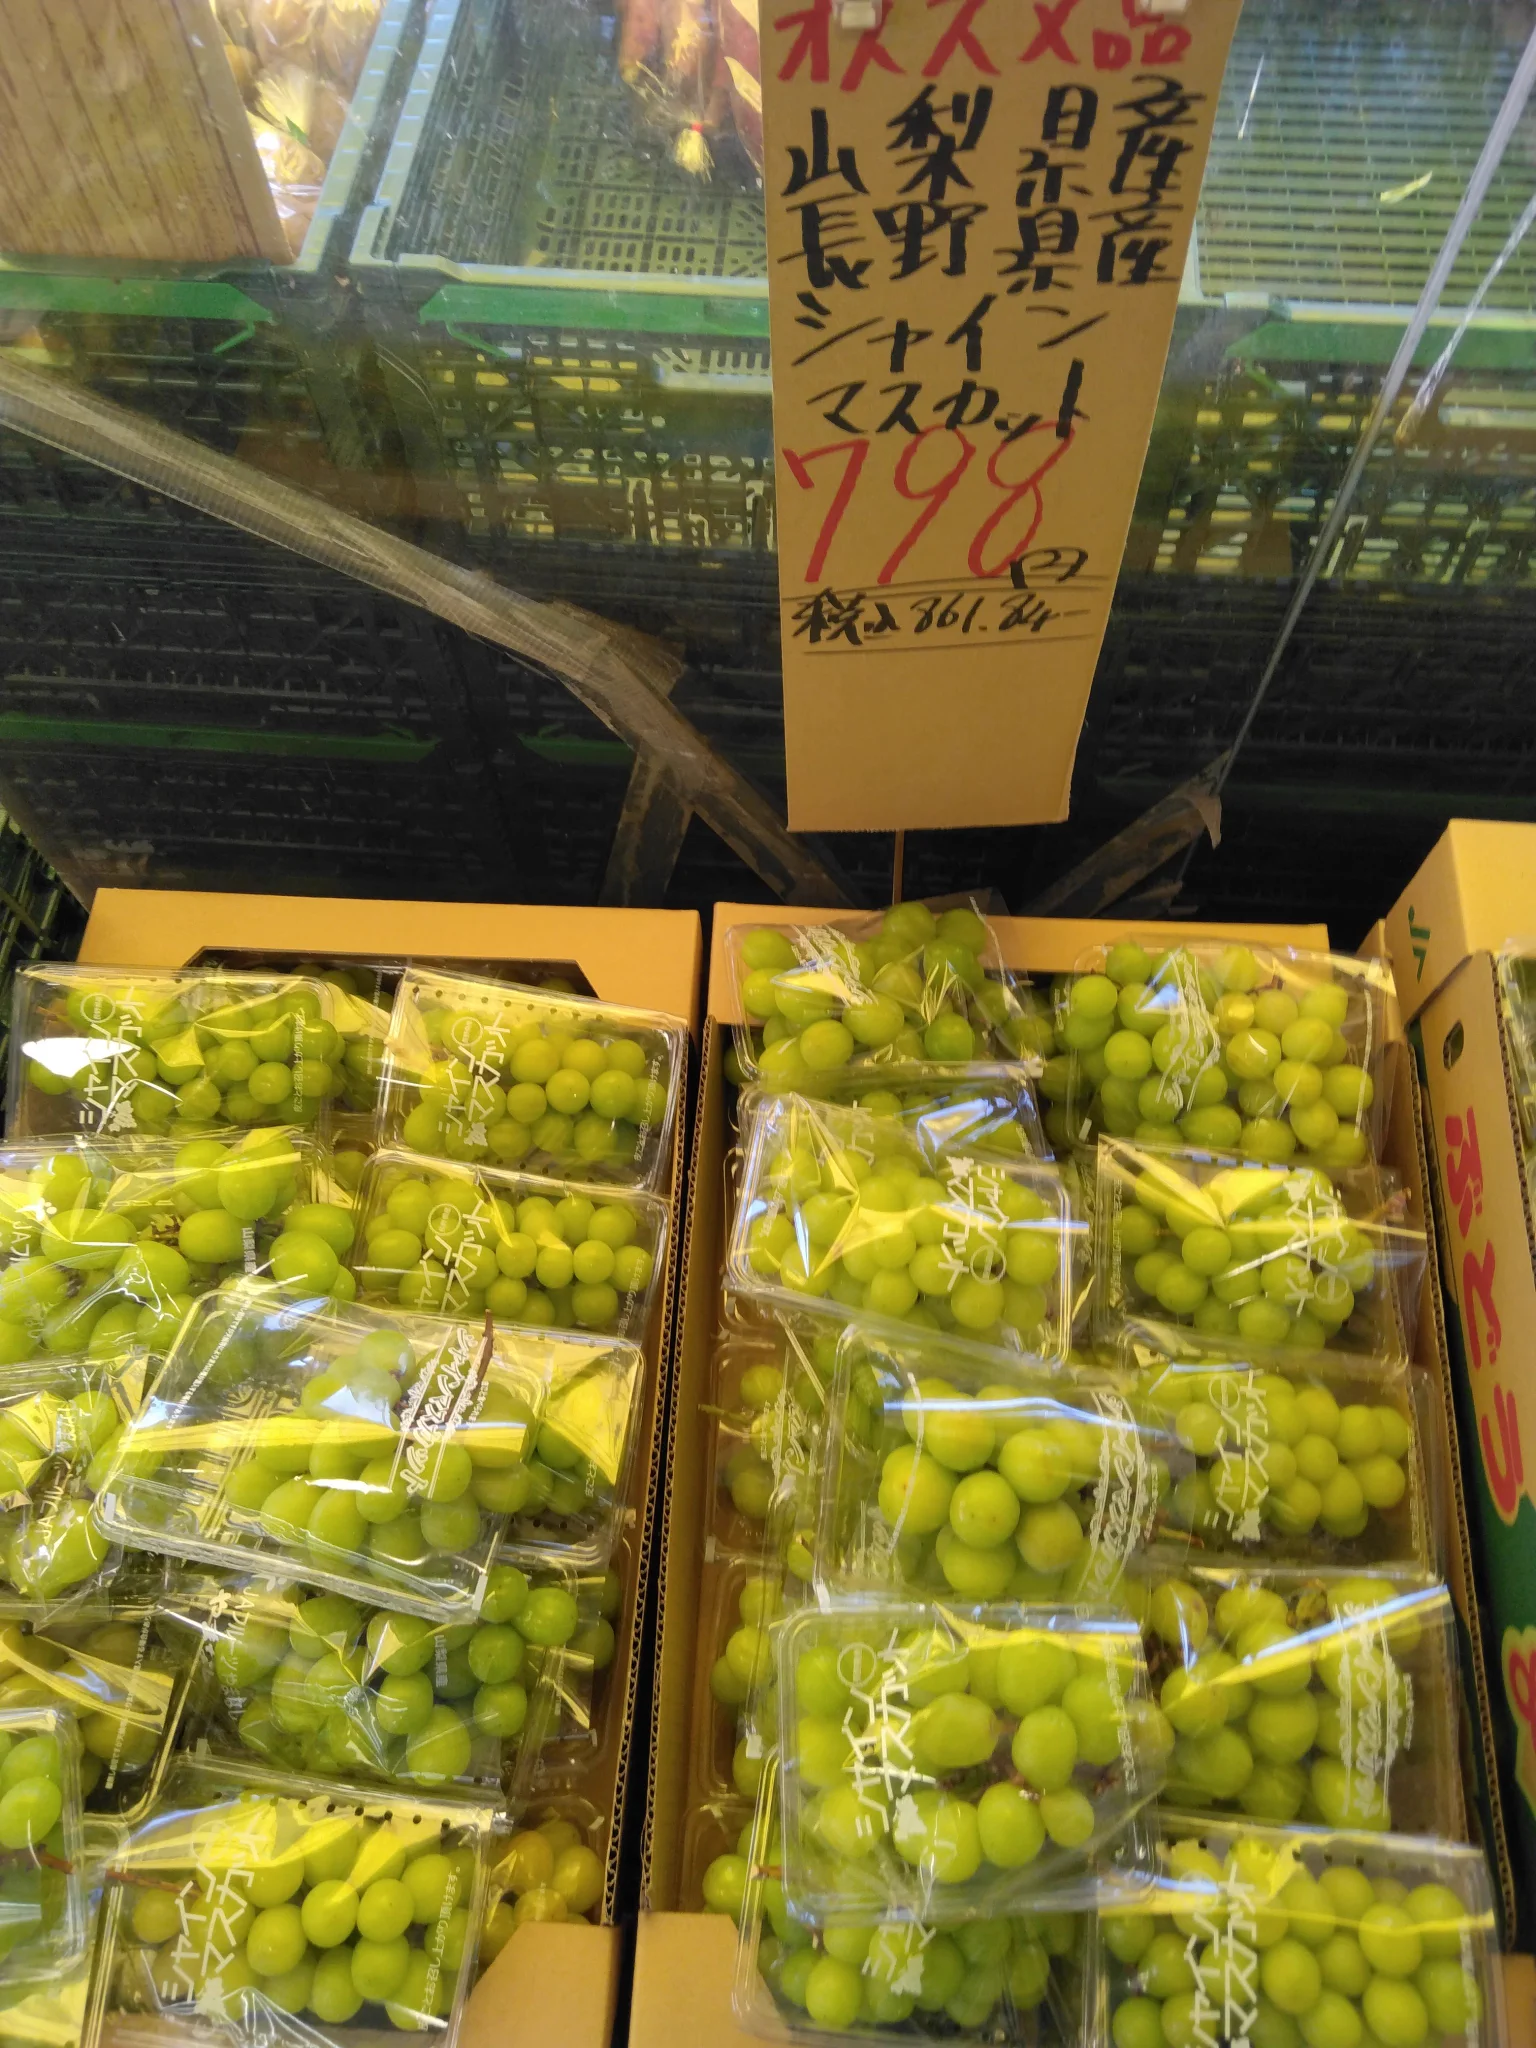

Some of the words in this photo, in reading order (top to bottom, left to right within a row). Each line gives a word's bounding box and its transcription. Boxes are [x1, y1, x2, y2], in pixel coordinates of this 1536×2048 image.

[781, 75, 1206, 206] 山梨県産
[777, 192, 1185, 293] 長野県産
[791, 292, 1110, 372] シャイン
[806, 359, 1090, 441] マスカット
[438, 1046, 476, 1137] シャイン
[467, 1012, 510, 1122] マスカット
[440, 1199, 491, 1314] マスカット
[1444, 1105, 1524, 1514] ぶどう
[1203, 1409, 1243, 1531] シャイン
[1239, 1368, 1269, 1509] マスカット
[841, 1687, 890, 1839] シャイン
[875, 1627, 915, 1801] マスカット
[161, 1861, 216, 2003] シャイン
[200, 1811, 267, 1977] マスカット
[1218, 1861, 1257, 2040] マスカット
